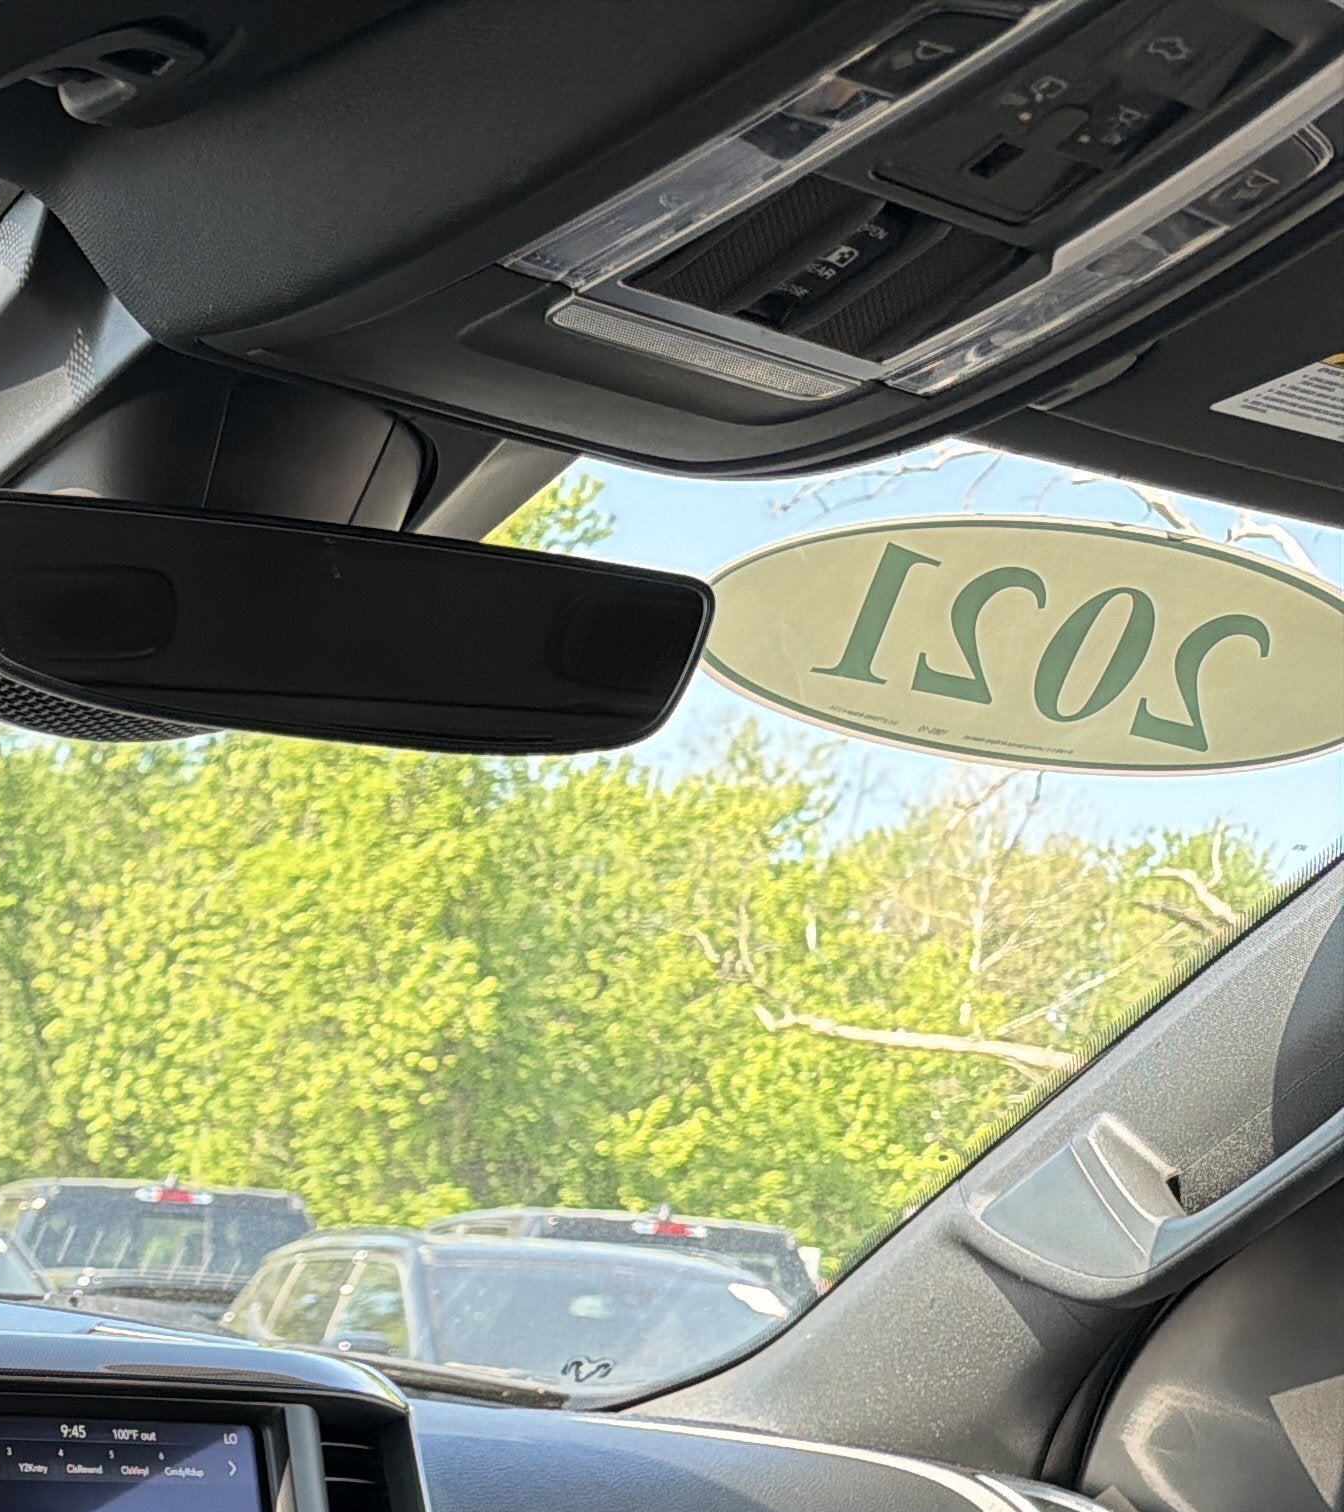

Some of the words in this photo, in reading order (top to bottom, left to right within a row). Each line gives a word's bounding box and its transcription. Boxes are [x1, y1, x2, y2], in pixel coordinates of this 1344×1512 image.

[60, 1424, 86, 1439] 9:45
[140, 1431, 157, 1442] out
[223, 1432, 238, 1445] LO
